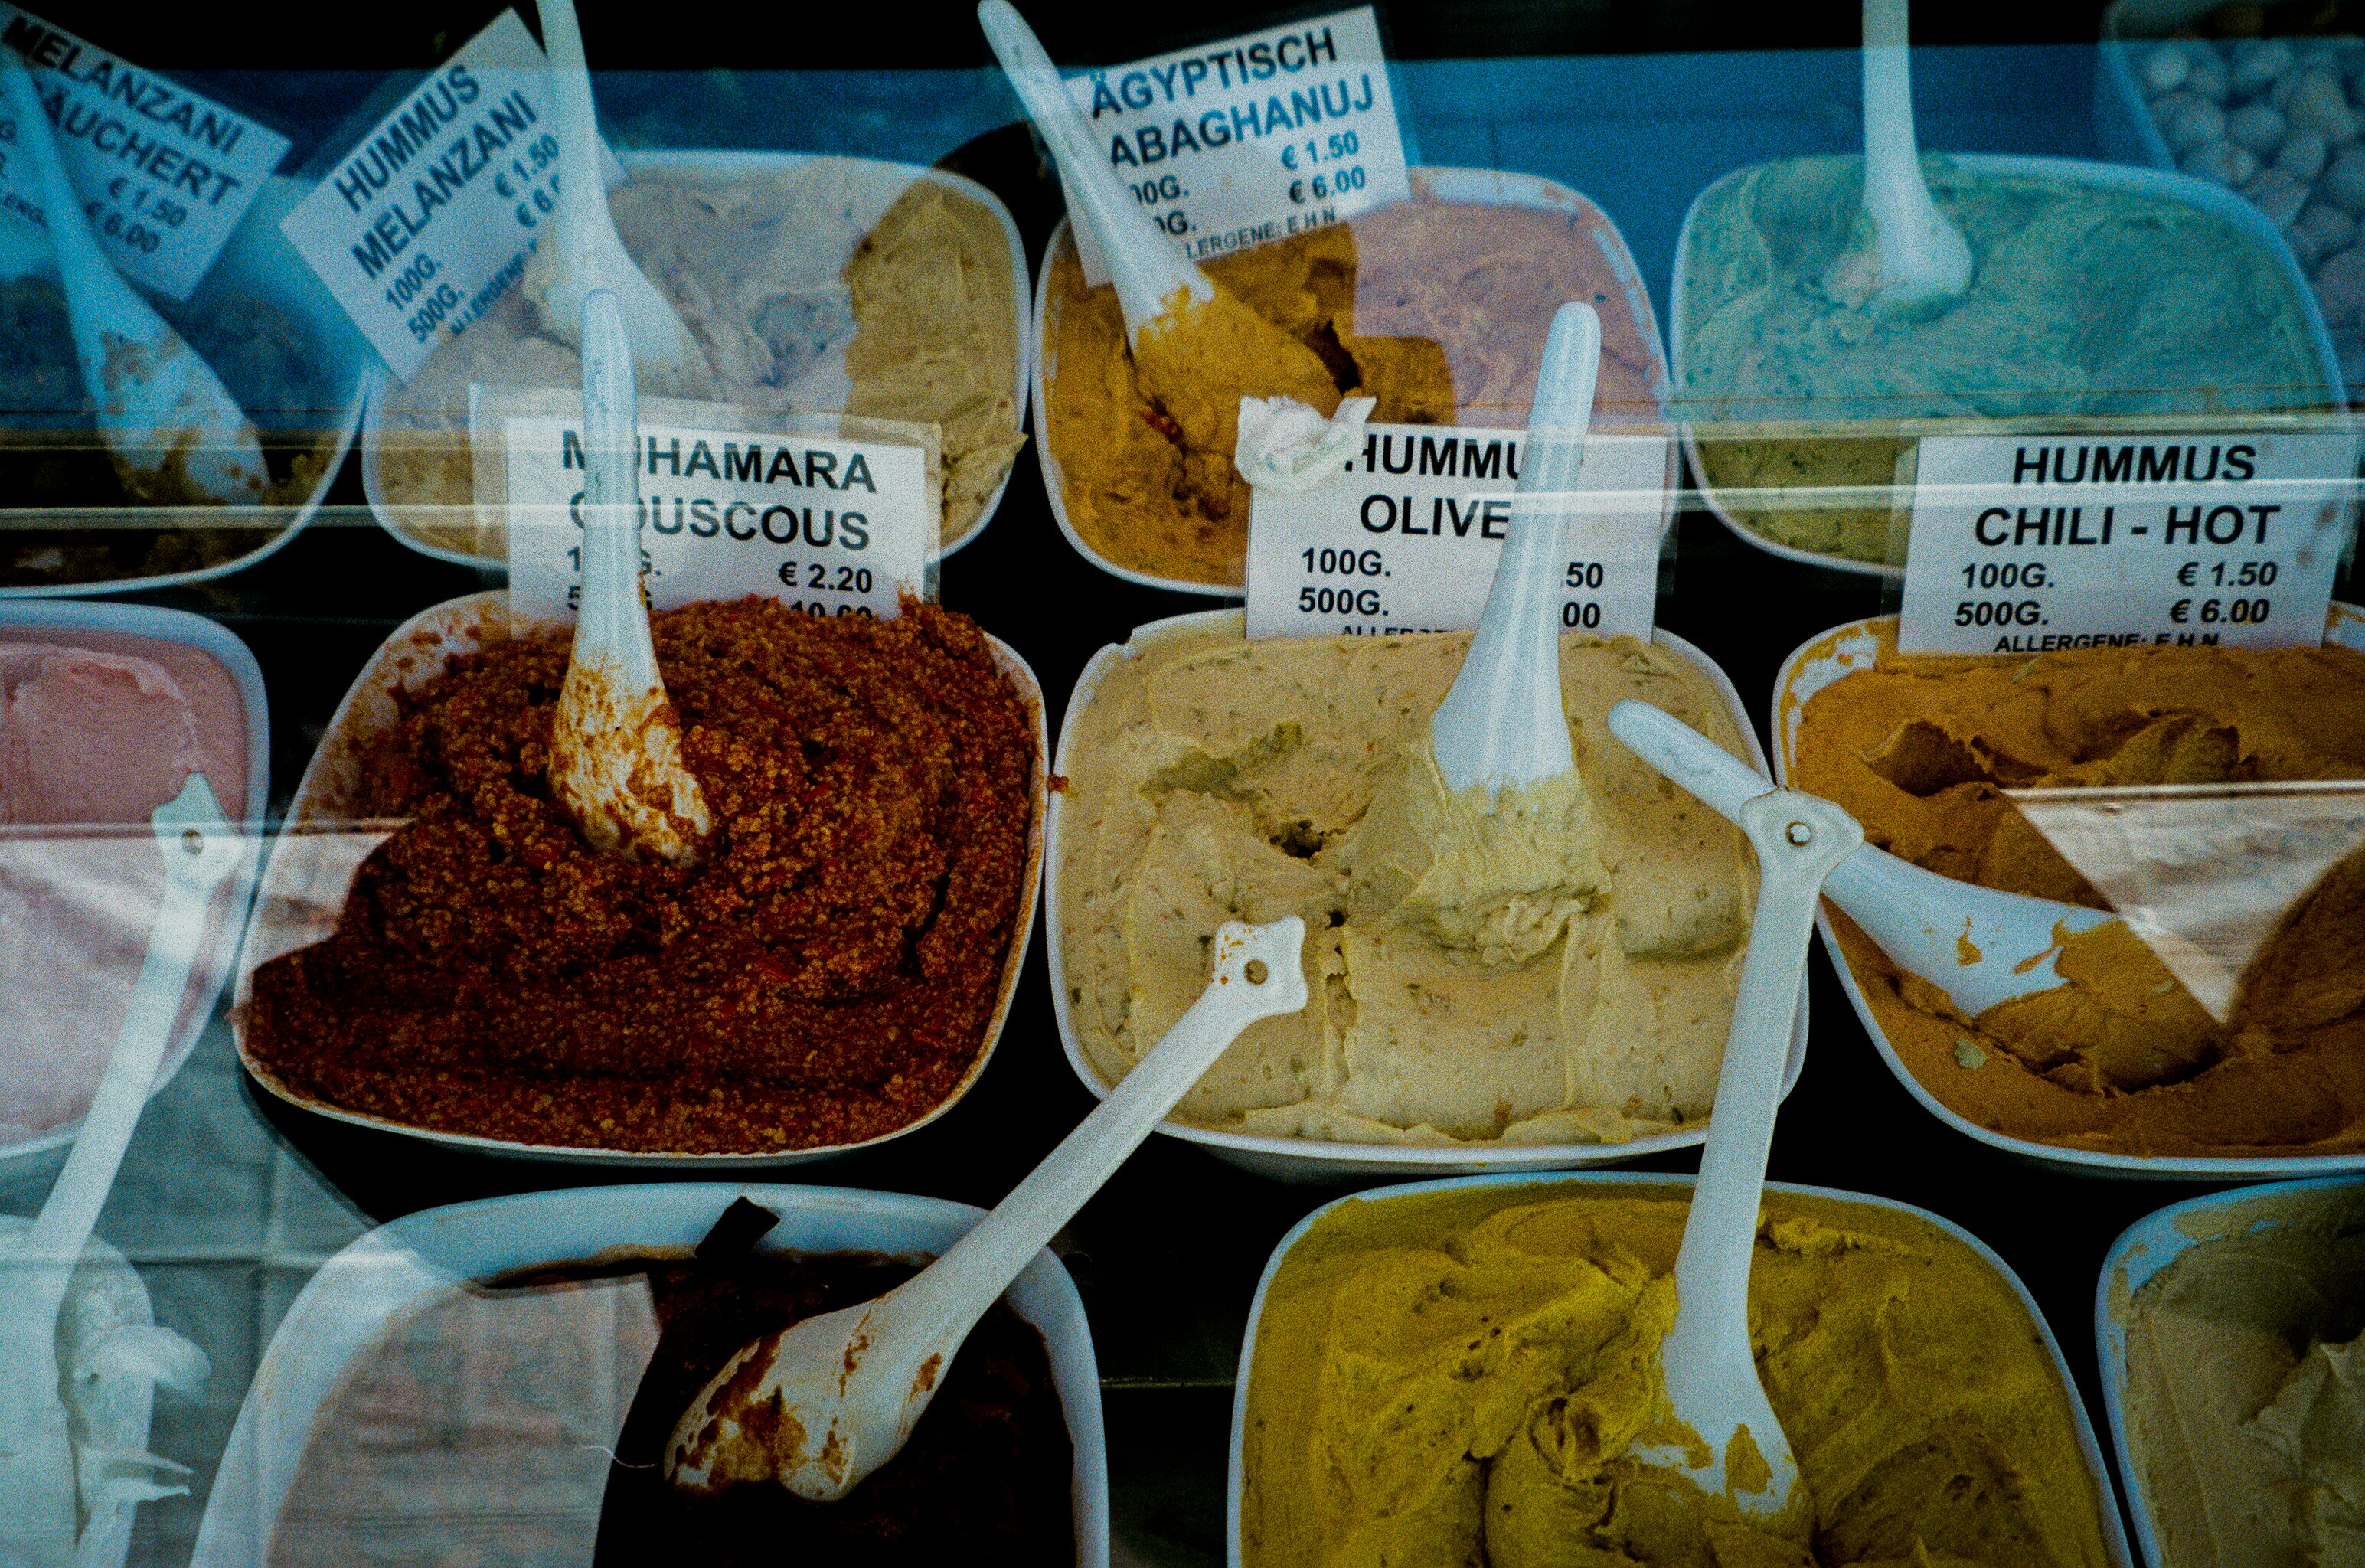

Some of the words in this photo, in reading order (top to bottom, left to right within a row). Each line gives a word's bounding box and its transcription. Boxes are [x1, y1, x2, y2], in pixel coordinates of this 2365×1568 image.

[2, 15, 243, 153] MELANZANI
[1090, 26, 1338, 120] ÄGYPTISCH
[334, 64, 481, 213] HUMMUS
[1281, 144, 1299, 171] €
[1305, 130, 1360, 165] 1.50
[351, 90, 537, 280] MELANZANI
[1289, 180, 1305, 204] €
[1312, 165, 1366, 199] 6.00
[384, 253, 443, 310] 100G.
[495, 172, 515, 198] €
[407, 283, 465, 343] 500G.
[516, 202, 537, 228] €
[563, 430, 877, 494] MHAMARA
[2013, 445, 2257, 484] HUMMUS
[1975, 506, 2115, 546] CHILI
[2165, 505, 2281, 545] HOT
[777, 560, 798, 587] €
[808, 563, 873, 593] 2.20
[1302, 547, 1392, 577] 100G.
[1962, 562, 2056, 589] 100G.
[2177, 561, 2198, 587] €
[2210, 561, 2278, 587] 1.50
[1298, 586, 1390, 616] 500G.
[1954, 601, 2050, 627] 500G.
[2170, 599, 2192, 624] €
[2200, 598, 2271, 624] 6.00
